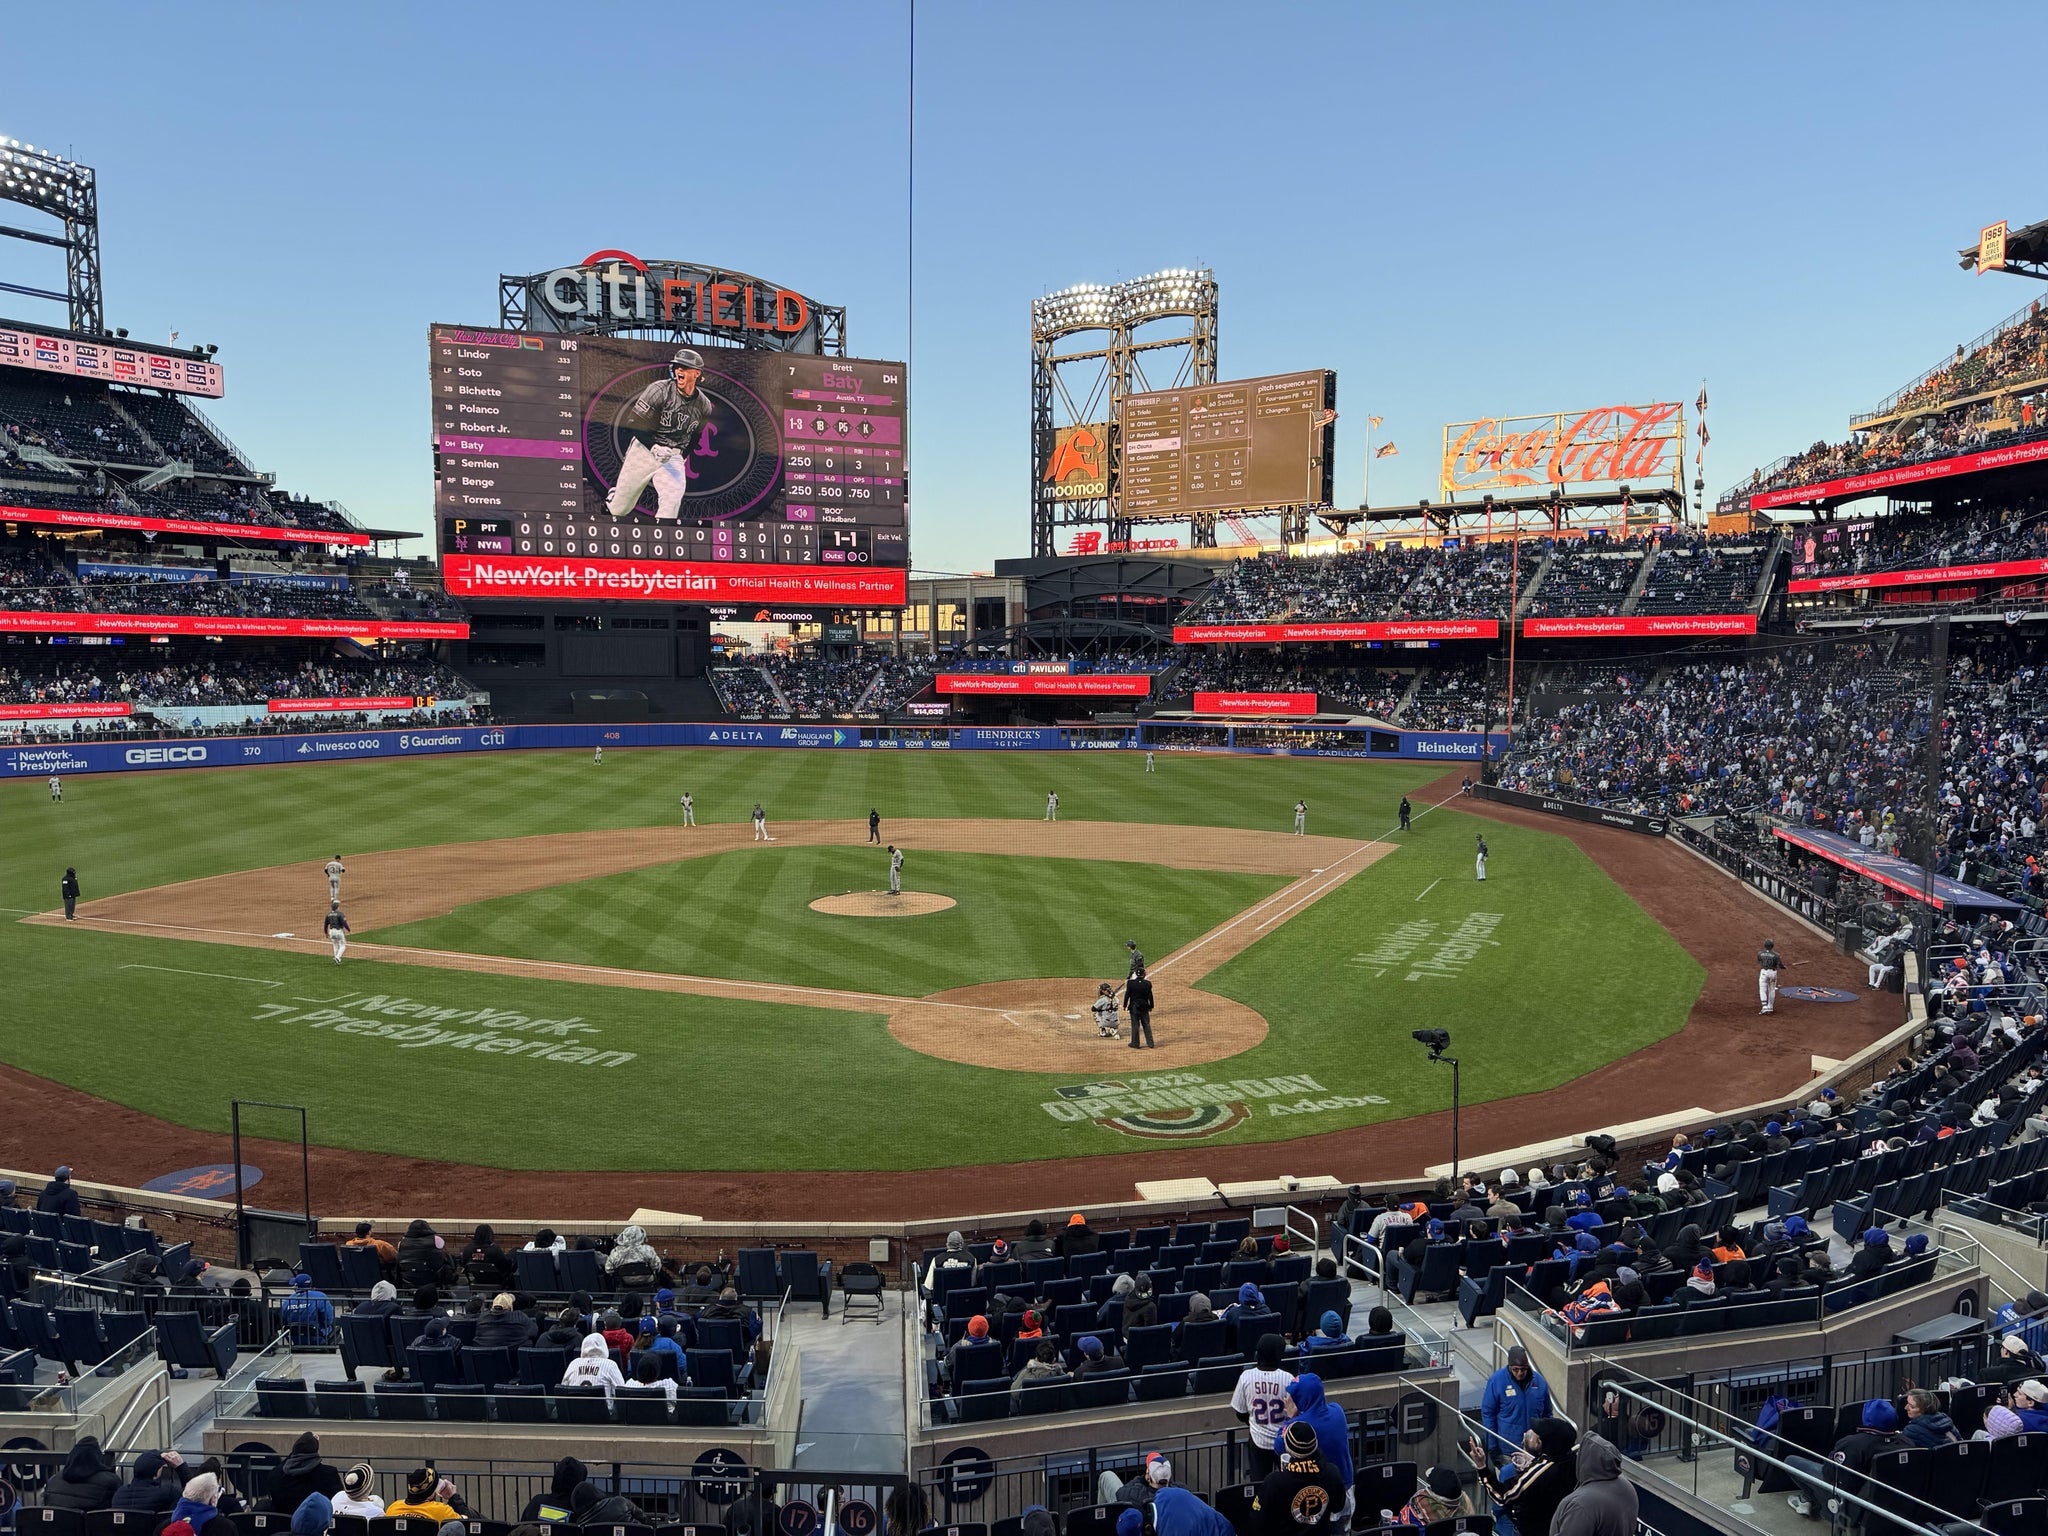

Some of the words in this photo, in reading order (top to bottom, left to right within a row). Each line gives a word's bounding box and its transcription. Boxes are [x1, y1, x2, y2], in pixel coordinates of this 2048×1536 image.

[1985, 226, 2003, 242] 1969
[664, 279, 808, 332] FIELD
[40, 340, 55, 349] AZ
[560, 339, 577, 351] OPS
[37, 351, 58, 361] LAD
[77, 346, 97, 356] ATH
[457, 349, 490, 360] Lindor
[77, 358, 98, 368] TOR
[115, 353, 135, 362] MIN
[151, 358, 171, 368] LAA
[115, 364, 135, 374] BAL
[187, 364, 205, 373] CLE
[458, 367, 482, 377] Soto
[789, 366, 796, 376] 7
[832, 363, 853, 372] Brett
[151, 370, 171, 379] HOU
[883, 375, 898, 384] DH
[822, 372, 864, 394] Baty
[1258, 385, 1275, 393] pitch
[1275, 381, 1305, 390] sequence
[459, 386, 502, 397] Bichette
[1217, 398, 1244, 407] Santana
[459, 404, 500, 415] Polanco
[460, 422, 495, 433] Robert
[496, 424, 511, 434] Jr.
[789, 418, 803, 430] 1-3
[816, 420, 825, 431] 1B
[838, 422, 849, 433] P5
[863, 423, 869, 434] K
[460, 441, 484, 451] Baty
[461, 458, 499, 469] Semien
[788, 457, 812, 467] .250
[825, 458, 834, 468] 0
[855, 460, 862, 470] 3
[885, 462, 890, 471] 1
[462, 476, 495, 488] Benge
[1771, 487, 1826, 503] NewYork-Presbyterian
[1844, 478, 1867, 489] Official
[1867, 474, 1888, 487] Health
[1895, 469, 1924, 481] Wellness
[1925, 464, 1951, 476] Partner
[789, 486, 812, 495] .250
[818, 487, 842, 497] .500
[848, 489, 870, 498] .750
[885, 490, 890, 500] 1
[1043, 483, 1105, 499] moomoo
[462, 495, 502, 505] Torrens
[62, 513, 142, 527] NewYork-Presbyterian
[822, 515, 856, 523] H3adband
[481, 523, 497, 533] PIT
[286, 531, 350, 543] NewYork-Presbyterian
[834, 531, 857, 547] 1-1
[1822, 532, 1840, 543] BATY
[477, 540, 502, 550] NYM
[1103, 541, 1127, 552] new
[1128, 538, 1178, 550] balance
[312, 580, 326, 588] BAR
[475, 566, 718, 595] NewYork-Presbyterian
[728, 575, 766, 589] Official
[768, 576, 801, 590] Health
[803, 578, 812, 590] &
[815, 577, 856, 591] Wellness
[858, 580, 894, 591] Partner
[773, 612, 813, 620] moomoo
[100, 620, 179, 630] NewYork-Presbyterian
[305, 625, 369, 634] NewYork-Presbyterian
[1390, 624, 1477, 635] NewYork-Presbyterian
[1540, 622, 1625, 632] NewYork-Presbyterian
[1653, 621, 1745, 631] NewYork-Presbyterian
[1193, 629, 1266, 639] NewYork-Presbyterian
[1287, 627, 1366, 637] NewYork-Presbyterian
[1030, 664, 1066, 673] PAVILION
[953, 680, 1019, 690] NewYork-Presbyterian
[1034, 681, 1055, 689] Official
[1056, 682, 1077, 690] Health
[1084, 682, 1111, 690] Wellness
[1222, 698, 1290, 708] NewYork-Presbyterian
[52, 705, 124, 715] NewYork-Presbyterian
[603, 731, 620, 740] 408
[722, 731, 763, 741] DELTA
[977, 730, 1041, 739] HENDRICK'S
[315, 741, 356, 752] Invesco
[357, 739, 380, 750] QQQ
[411, 735, 462, 747] Guardian
[244, 747, 261, 756] 370
[1158, 744, 1201, 752] CADILLAC
[1417, 741, 1478, 754] Heineken
[19, 750, 73, 761] NewYork-
[125, 746, 207, 764] GEICO
[19, 759, 88, 772] Presbyterian
[338, 994, 604, 1036] NewYork-
[280, 1008, 637, 1068] Presbyterian
[1129, 1072, 1208, 1091] 2026
[1041, 1084, 1238, 1123] OPENING
[1237, 1073, 1329, 1099] DAY
[1266, 1093, 1391, 1117] Adobe
[578, 1365, 600, 1377] NIMMO
[1254, 1381, 1280, 1396] SOTO
[1252, 1398, 1285, 1425] 22
[1403, 1402, 1425, 1434] E
[790, 1509, 808, 1528] 17
[849, 1508, 866, 1528] 16
